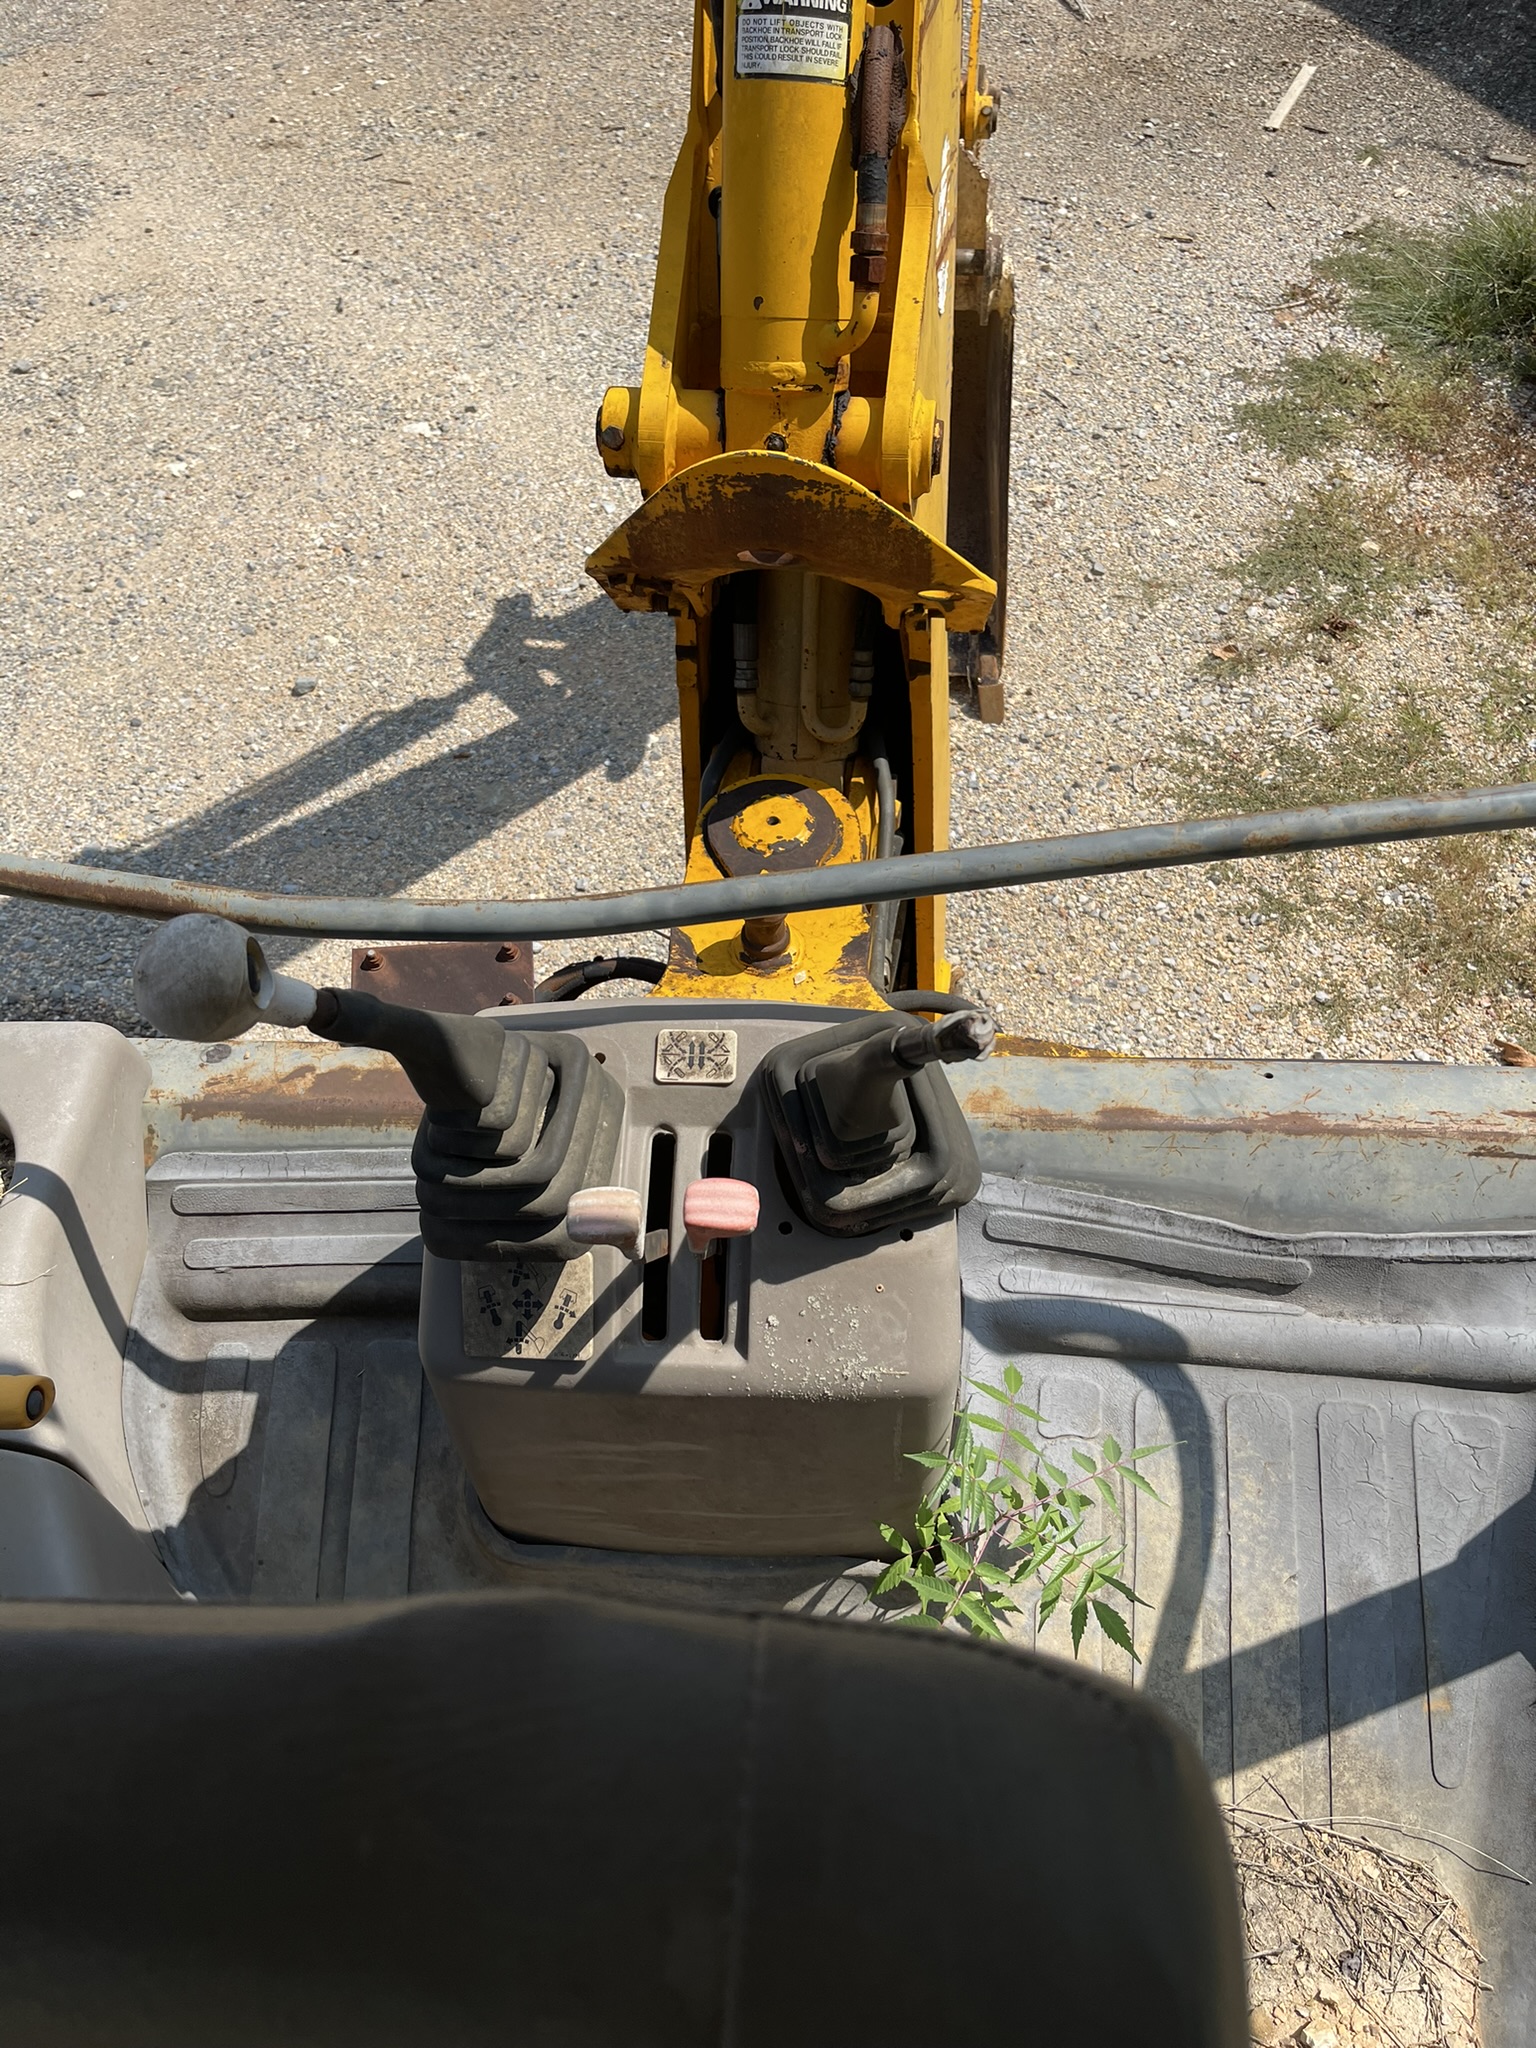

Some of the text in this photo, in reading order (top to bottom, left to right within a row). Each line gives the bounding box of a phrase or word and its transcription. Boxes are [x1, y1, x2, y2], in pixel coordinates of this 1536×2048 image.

[763, 0, 848, 13] NING
[742, 18, 843, 33] DO NOT LIFT OBJECTS WITH
[742, 26, 843, 41] BACKHOE IN TRANSPORT LOCK
[770, 35, 804, 45] BACKHOE
[804, 38, 821, 47] WILL
[821, 40, 836, 50] FALL
[836, 42, 842, 50] IF
[741, 44, 778, 53] TRANSPORT
[779, 45, 800, 54] LOCK
[801, 46, 829, 57] SHOULD
[741, 52, 839, 68] THIS COULD RESULT IN SEVERE
